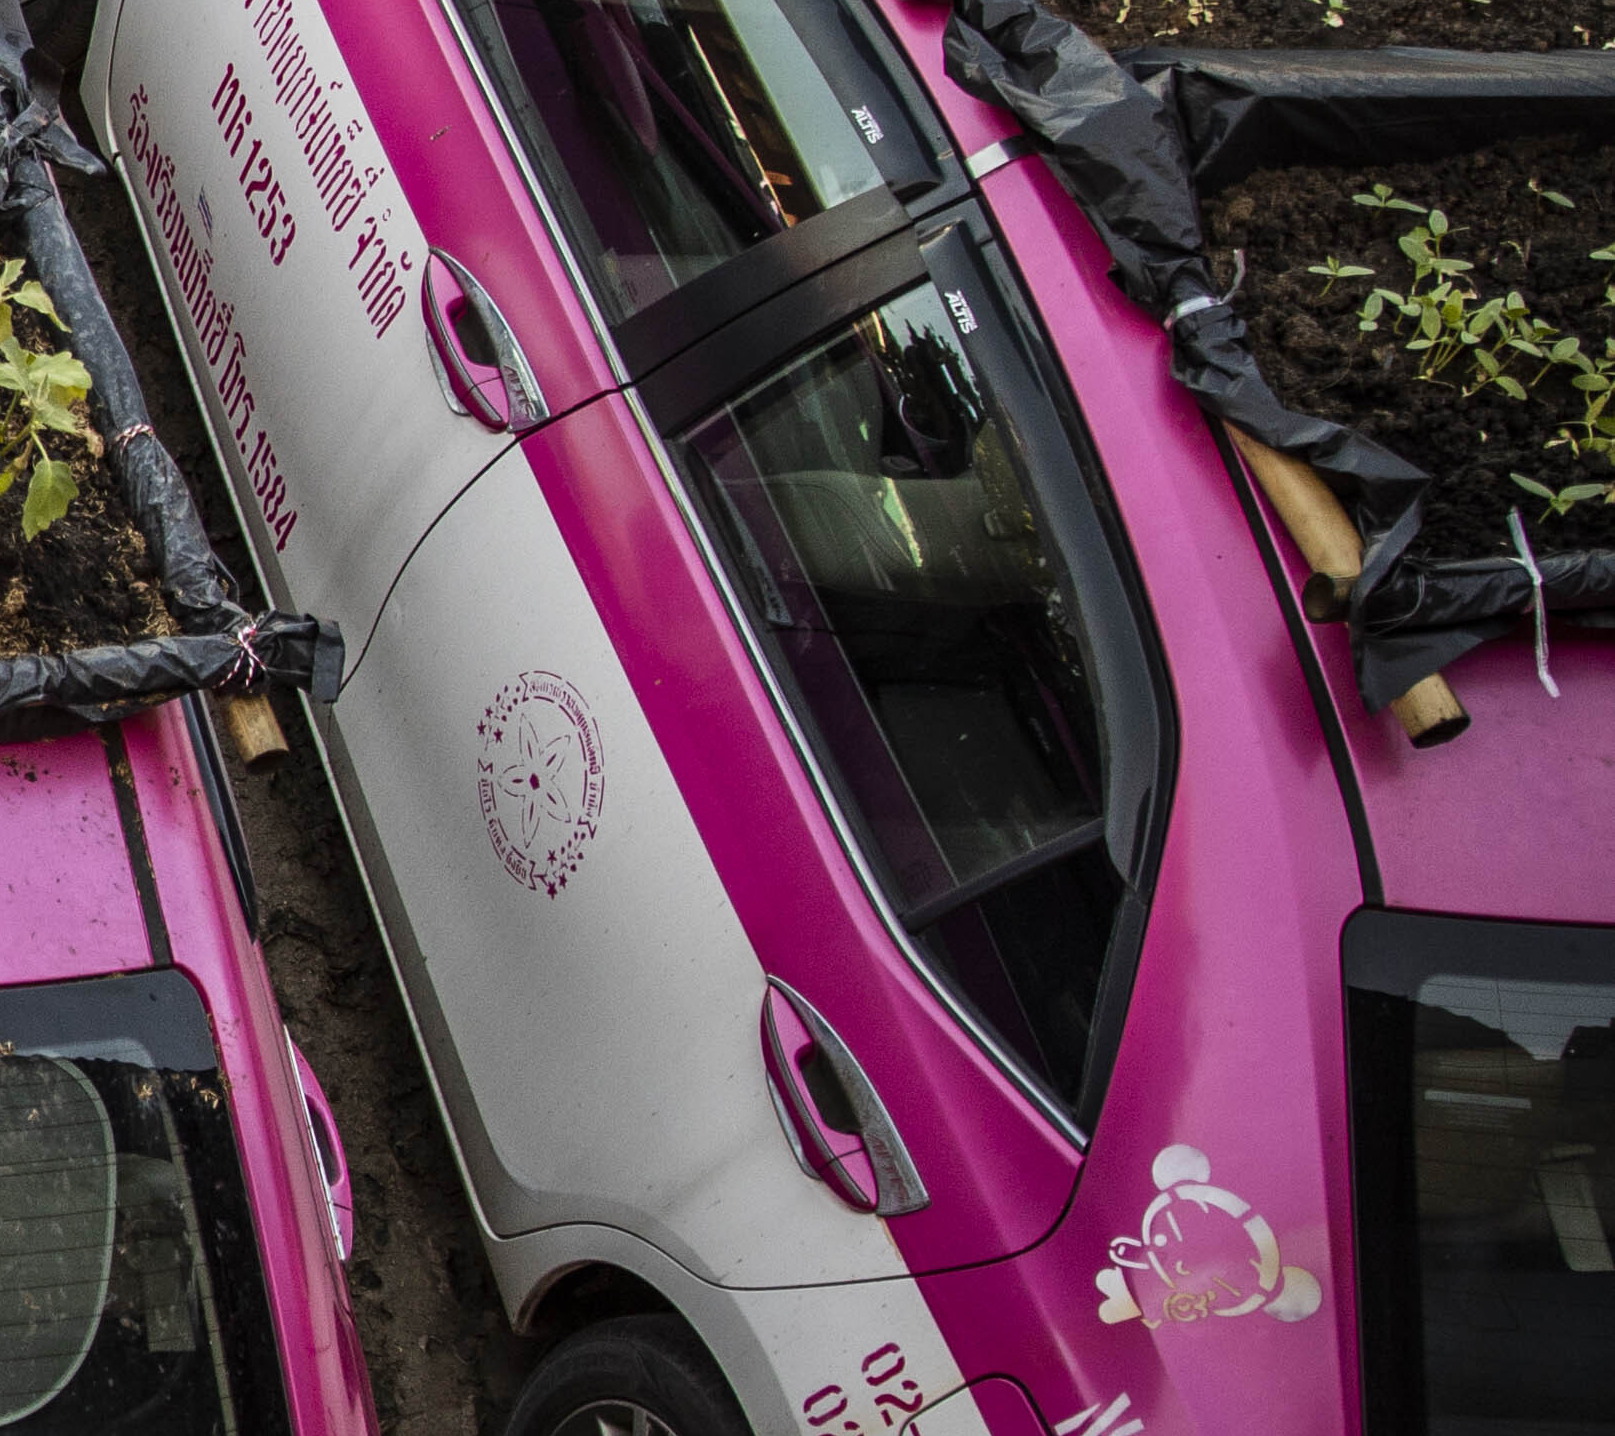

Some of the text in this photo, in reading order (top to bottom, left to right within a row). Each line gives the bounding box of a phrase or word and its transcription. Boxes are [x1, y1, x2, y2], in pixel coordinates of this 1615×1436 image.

[210, 62, 298, 267] ทห 1253
[851, 108, 882, 145] ALTIS
[349, 206, 415, 340] จำกัด
[944, 290, 976, 334] ALTIS
